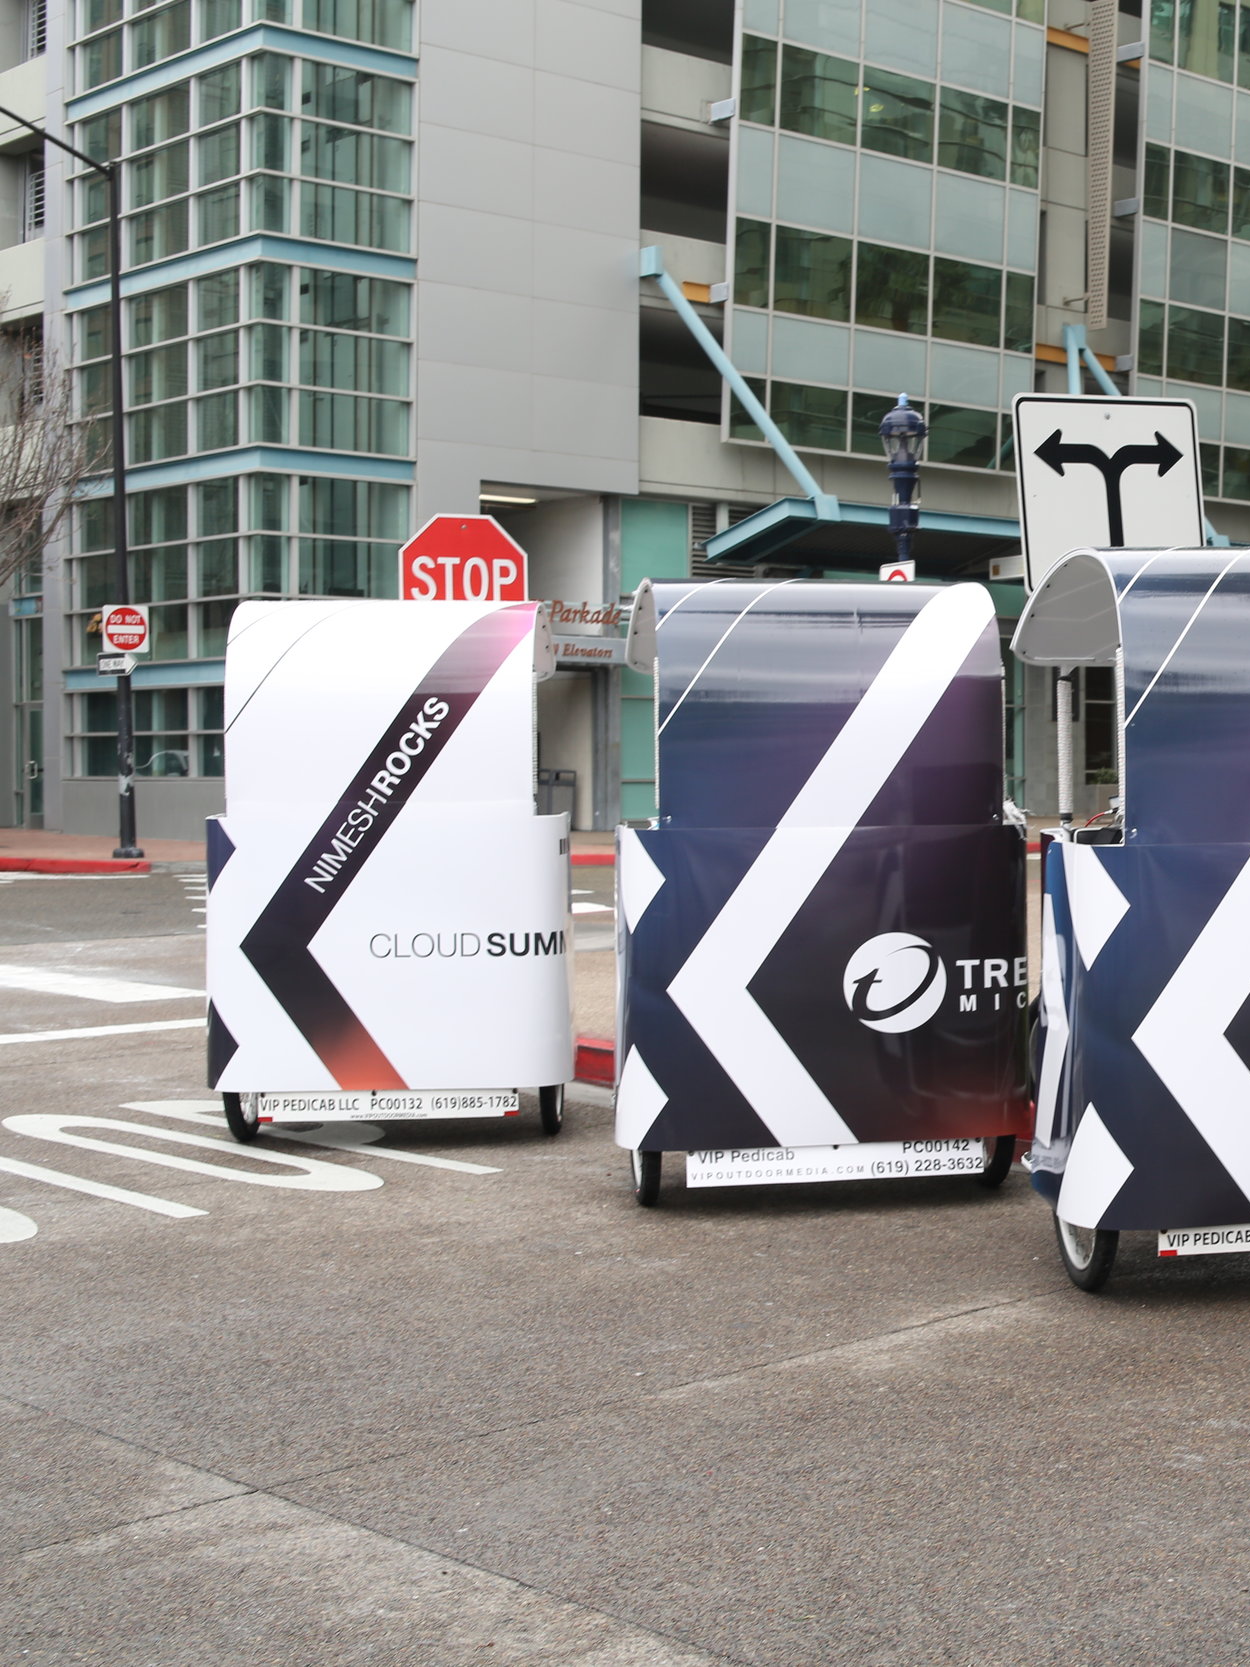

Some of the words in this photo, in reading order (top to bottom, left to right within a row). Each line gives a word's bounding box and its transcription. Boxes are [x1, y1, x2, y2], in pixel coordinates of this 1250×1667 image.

[411, 555, 518, 601] STOP
[110, 614, 122, 623] DO
[125, 614, 142, 624] NOT
[550, 600, 622, 624] Parkade
[113, 634, 139, 644] ENTER
[562, 643, 613, 658] Elevators
[260, 1098, 279, 1111] VIP
[283, 1098, 335, 1111] PEDICAB
[339, 1098, 360, 1111] LLC
[371, 1097, 423, 1110] PC00132
[431, 1095, 517, 1110] (619)885-1782
[700, 1150, 724, 1164] VIP
[731, 1148, 795, 1163] Pedicab
[902, 1139, 970, 1154] PC00142
[691, 1166, 864, 1181] VIPOUTDOORMEDIA.COM
[871, 1161, 909, 1176] (619)
[914, 1157, 984, 1172] 228-3632
[1168, 1233, 1190, 1248] VIP
